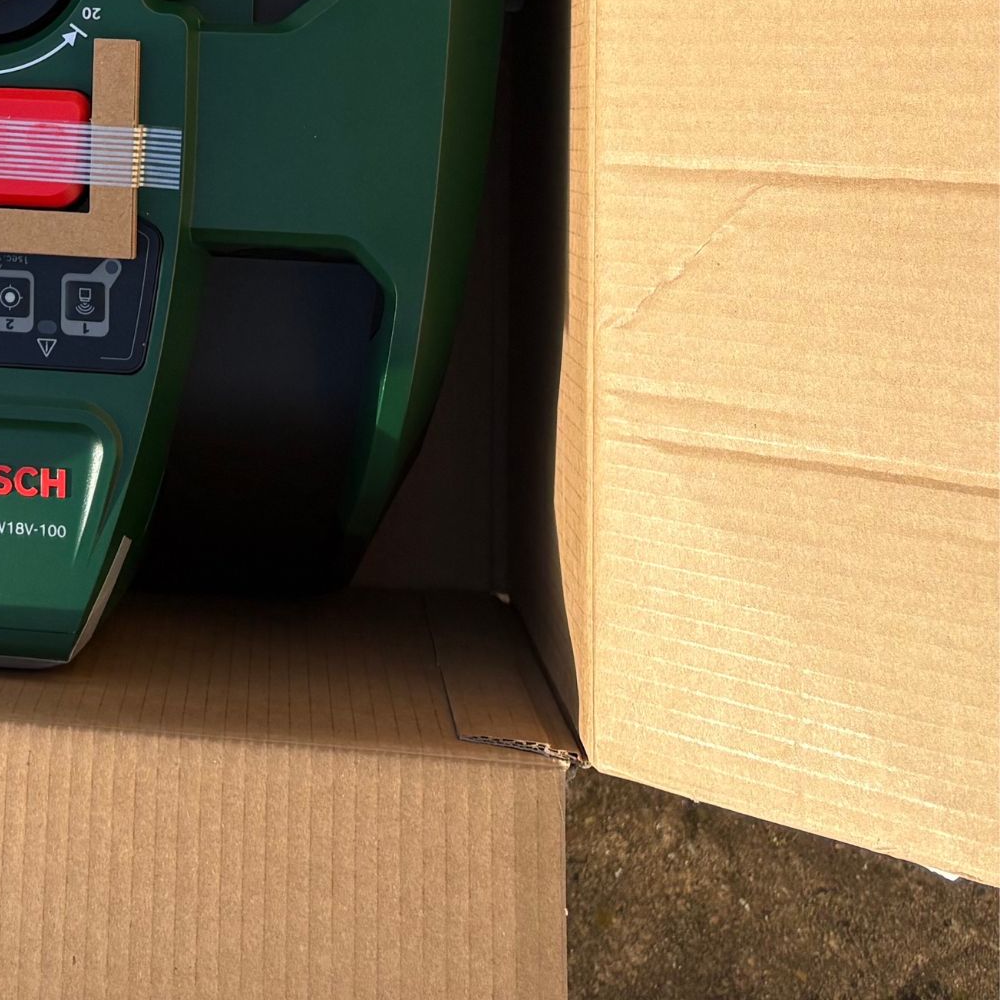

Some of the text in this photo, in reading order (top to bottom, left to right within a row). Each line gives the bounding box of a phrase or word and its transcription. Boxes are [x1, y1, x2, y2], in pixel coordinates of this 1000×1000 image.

[82, 7, 101, 20] 20
[6, 319, 14, 330] 2
[82, 323, 90, 334] 1
